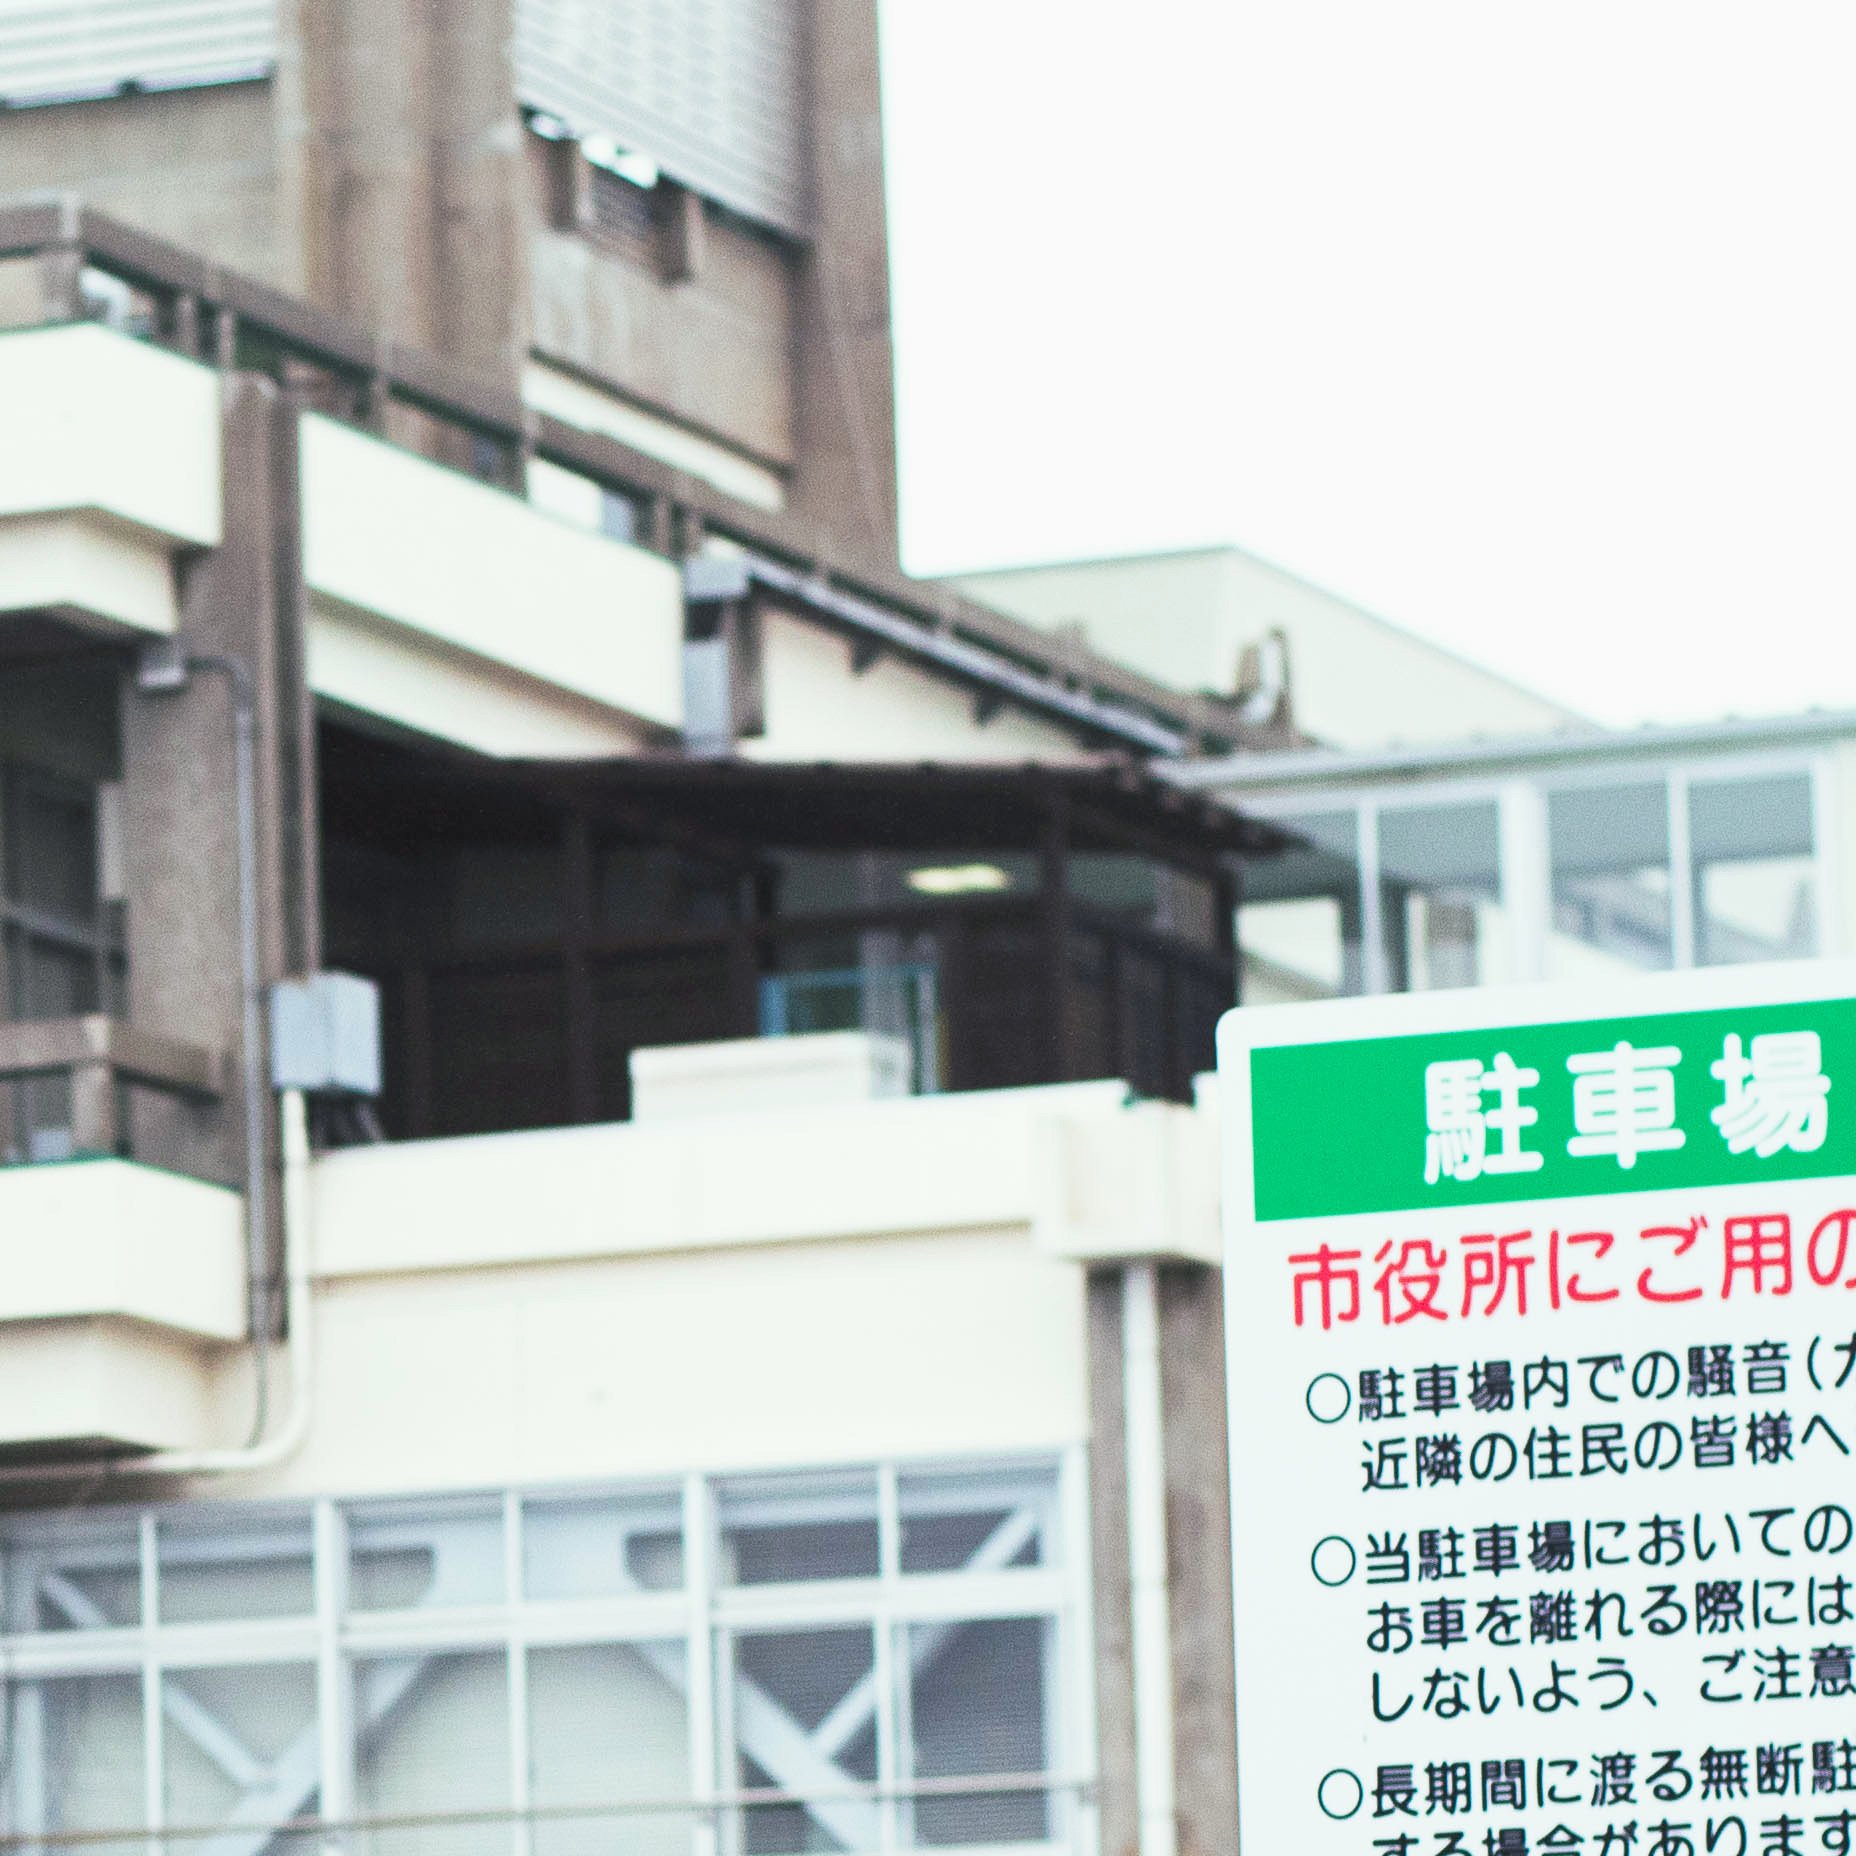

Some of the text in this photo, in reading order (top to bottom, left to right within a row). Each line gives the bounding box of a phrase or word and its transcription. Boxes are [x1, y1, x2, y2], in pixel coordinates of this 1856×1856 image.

[1424, 1030, 1832, 1184] 駐車場
[1287, 1209, 1856, 1330] 市役所にご用の
[1361, 1410, 1850, 1492] 近隣の住民の皆様へ
[1365, 1504, 1854, 1585] 当駐車場においての
[1366, 1574, 1856, 1654] お車を離れる際には
[1371, 1643, 1856, 1722] しないよう、ご注意
[1371, 1738, 1856, 1819] 長期間に渡る無断駐
